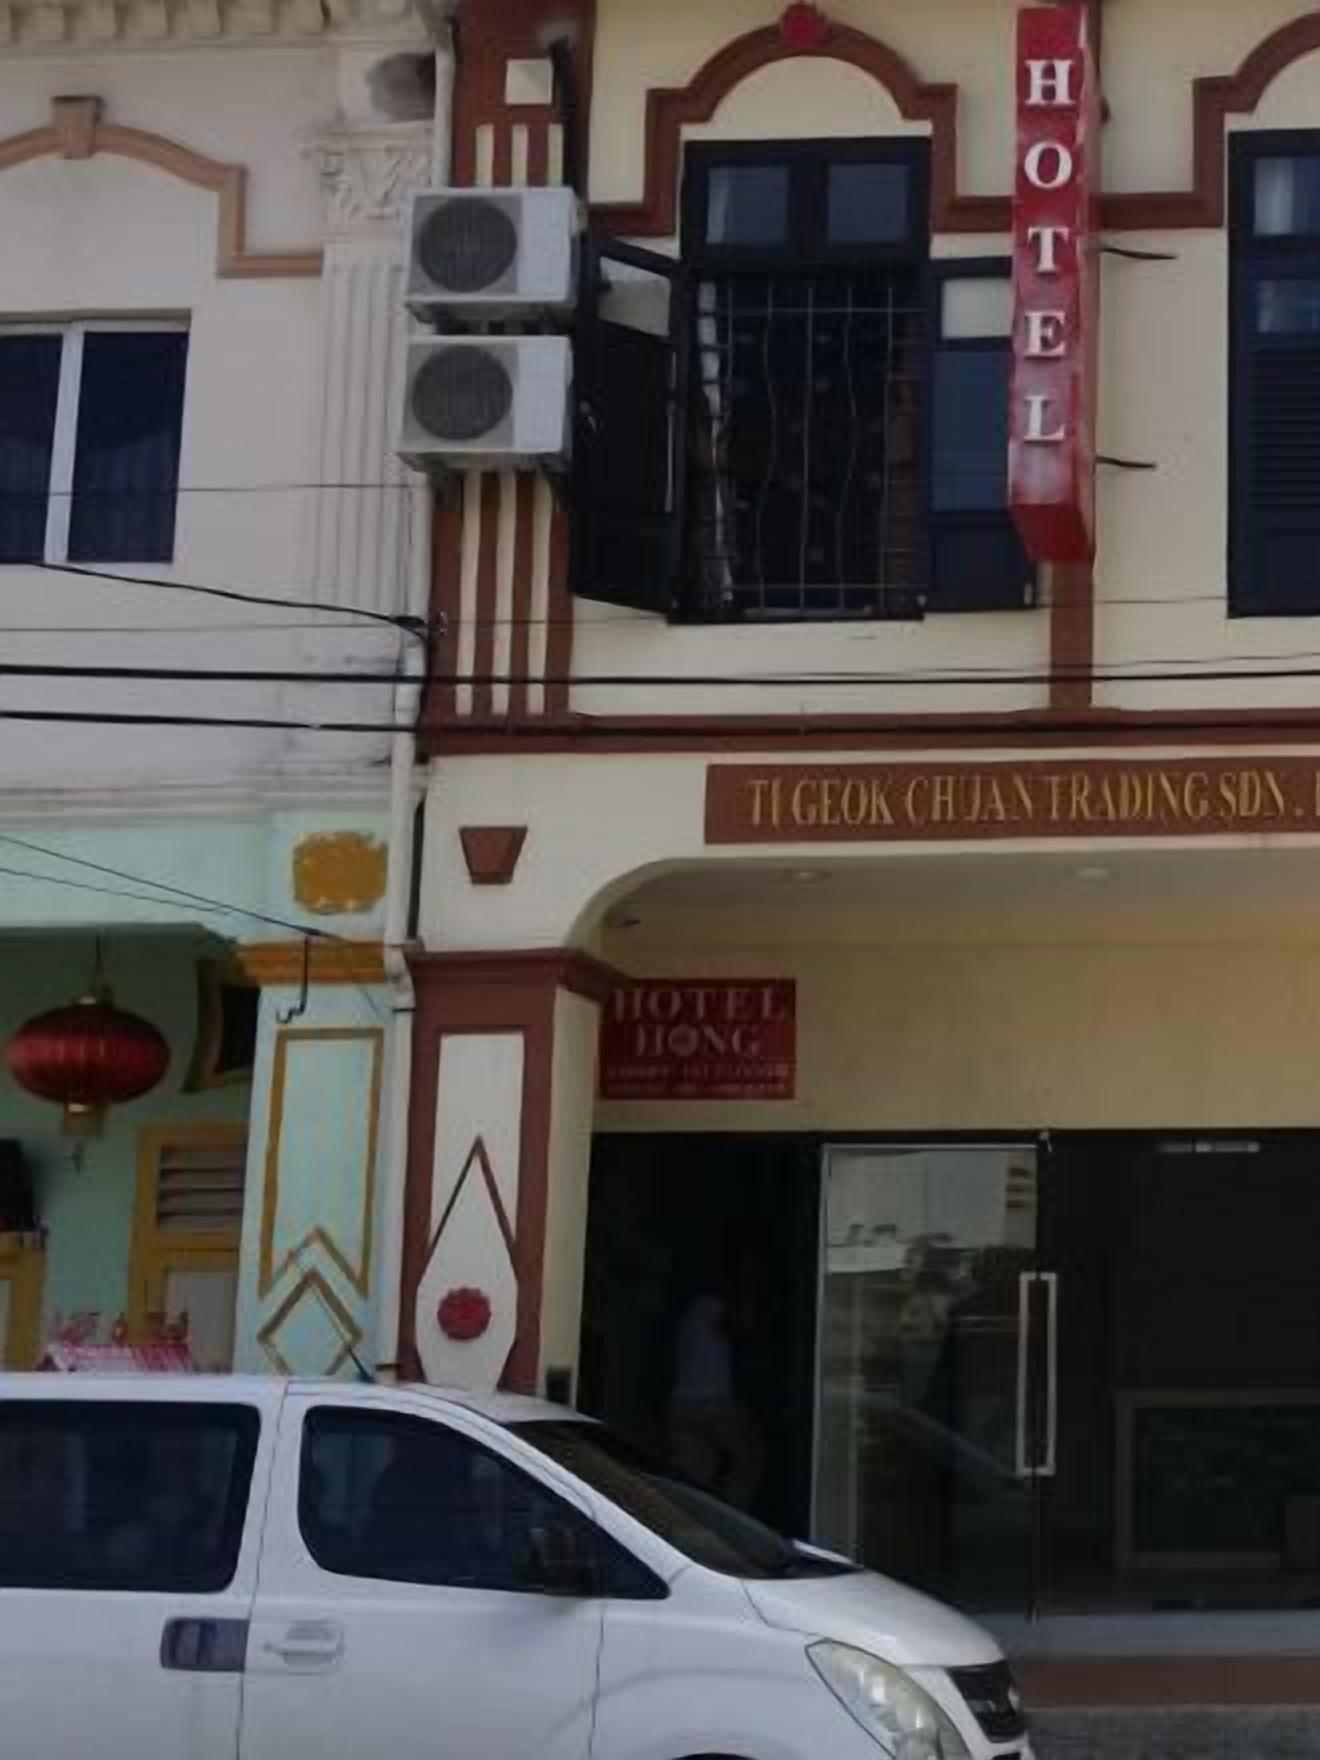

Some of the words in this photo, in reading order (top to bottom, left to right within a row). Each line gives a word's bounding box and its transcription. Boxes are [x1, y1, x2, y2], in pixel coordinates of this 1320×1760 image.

[1024, 59, 1074, 443] HOTEL
[791, 780, 895, 826] GEOK
[906, 777, 1035, 823] CHUAN
[1044, 771, 1209, 821] TRADING
[614, 988, 793, 1021] HOTEL
